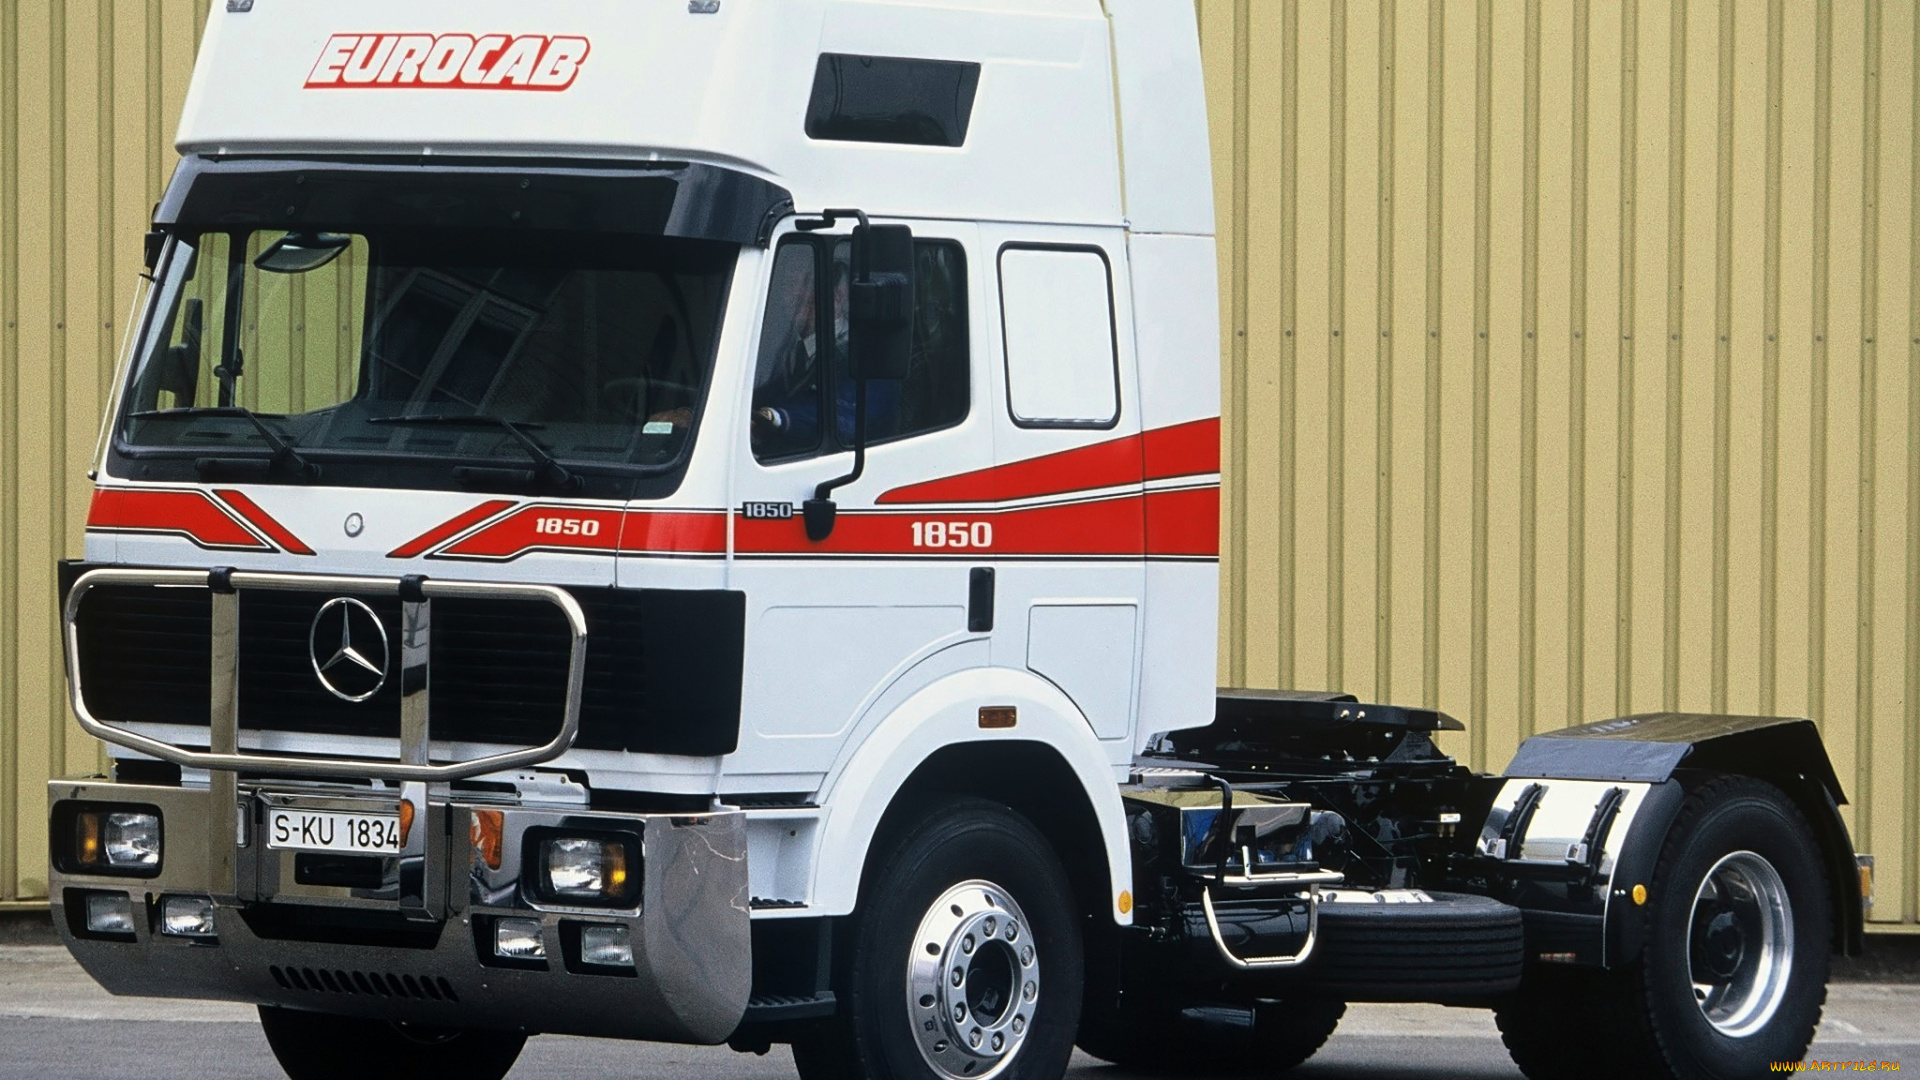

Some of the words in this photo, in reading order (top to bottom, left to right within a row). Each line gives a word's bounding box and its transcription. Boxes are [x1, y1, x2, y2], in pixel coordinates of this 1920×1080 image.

[304, 33, 590, 90] EUROCAB
[744, 502, 793, 519] 1850
[535, 518, 600, 537] 1850
[910, 521, 993, 548] 1850
[274, 814, 334, 846] S-KU
[347, 819, 399, 849] 1834
